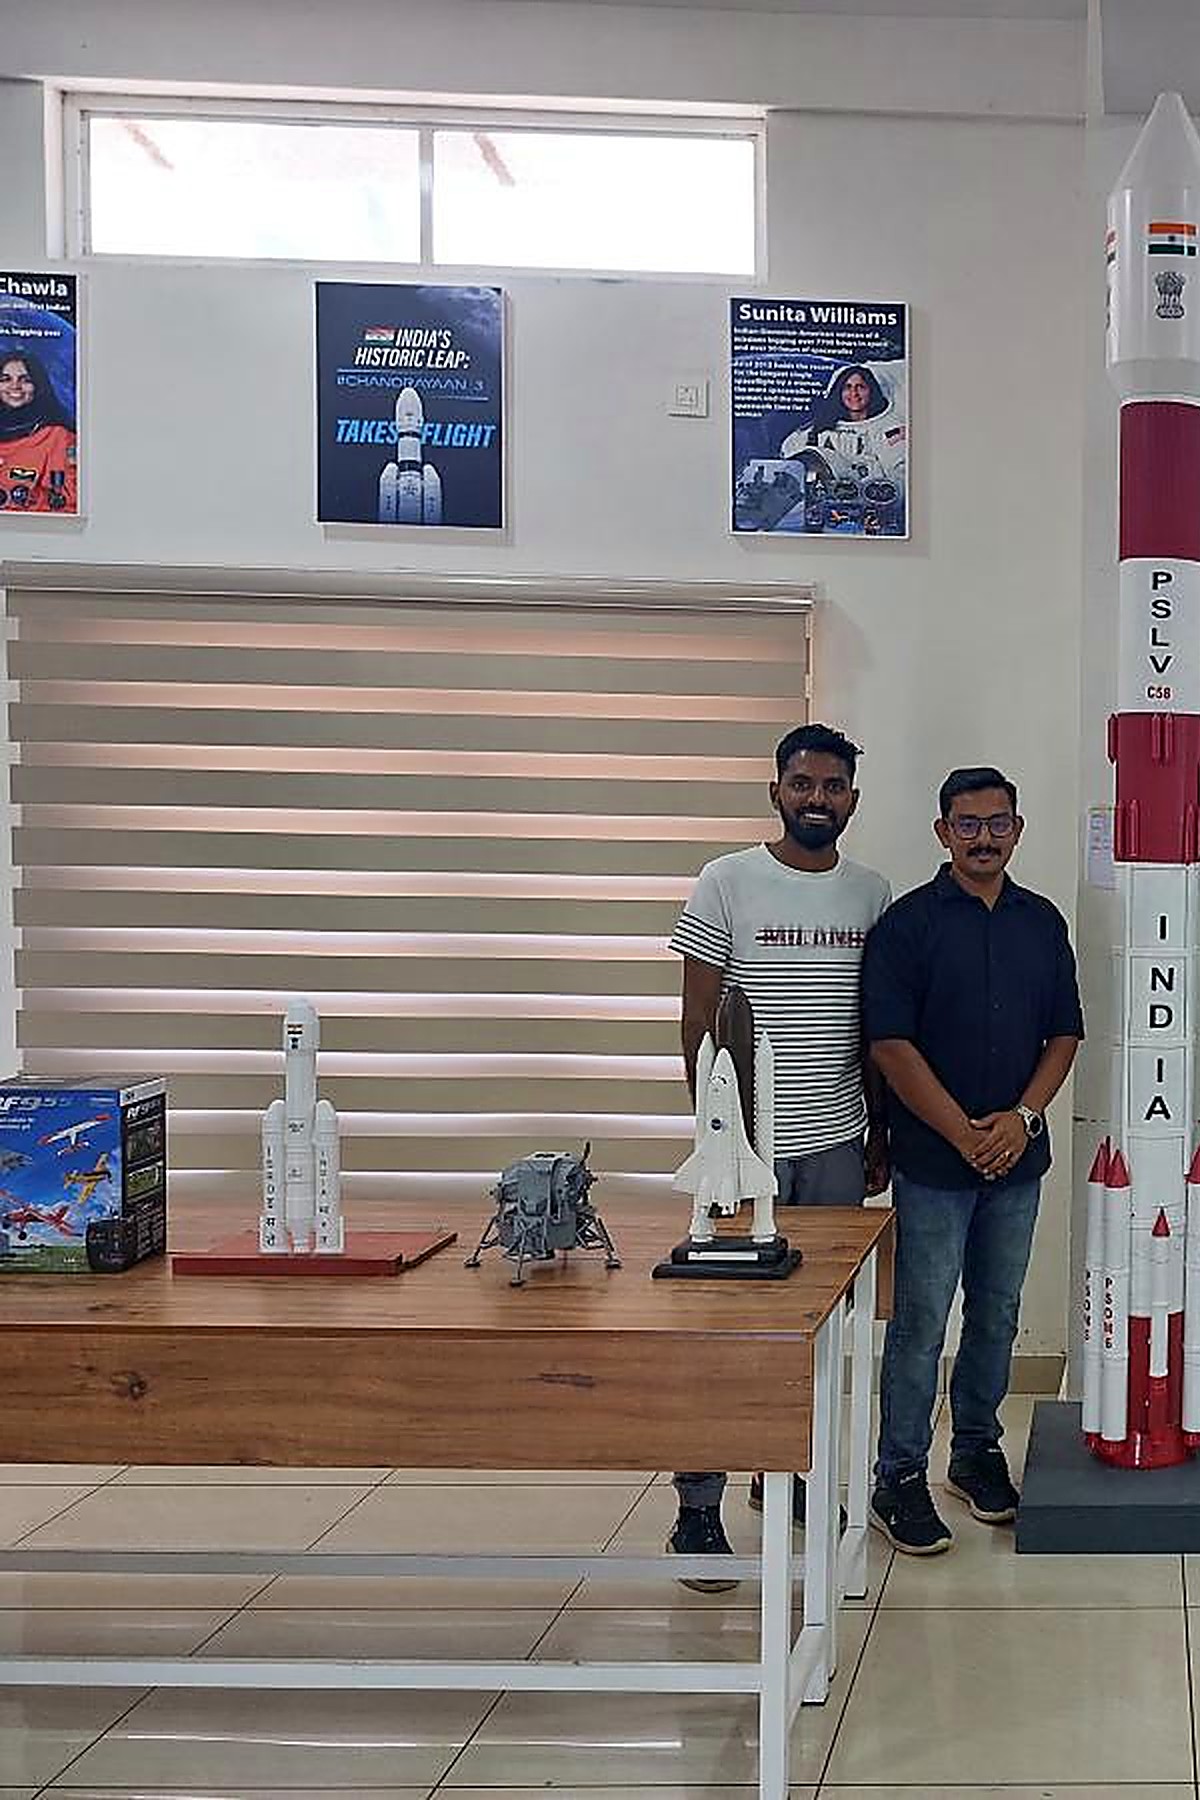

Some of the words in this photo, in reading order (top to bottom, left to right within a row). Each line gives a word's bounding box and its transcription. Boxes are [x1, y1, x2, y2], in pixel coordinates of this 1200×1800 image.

[739, 304, 806, 322] Sunita
[810, 307, 897, 325] Williams
[395, 329, 452, 349] INDIA'S
[355, 349, 423, 367] HISTORIC
[427, 350, 470, 369] LEAP:
[336, 420, 399, 444] TAKES
[420, 422, 496, 448] FLIGHT
[1150, 571, 1173, 674] PSLV
[1144, 915, 1175, 1121] INDIA
